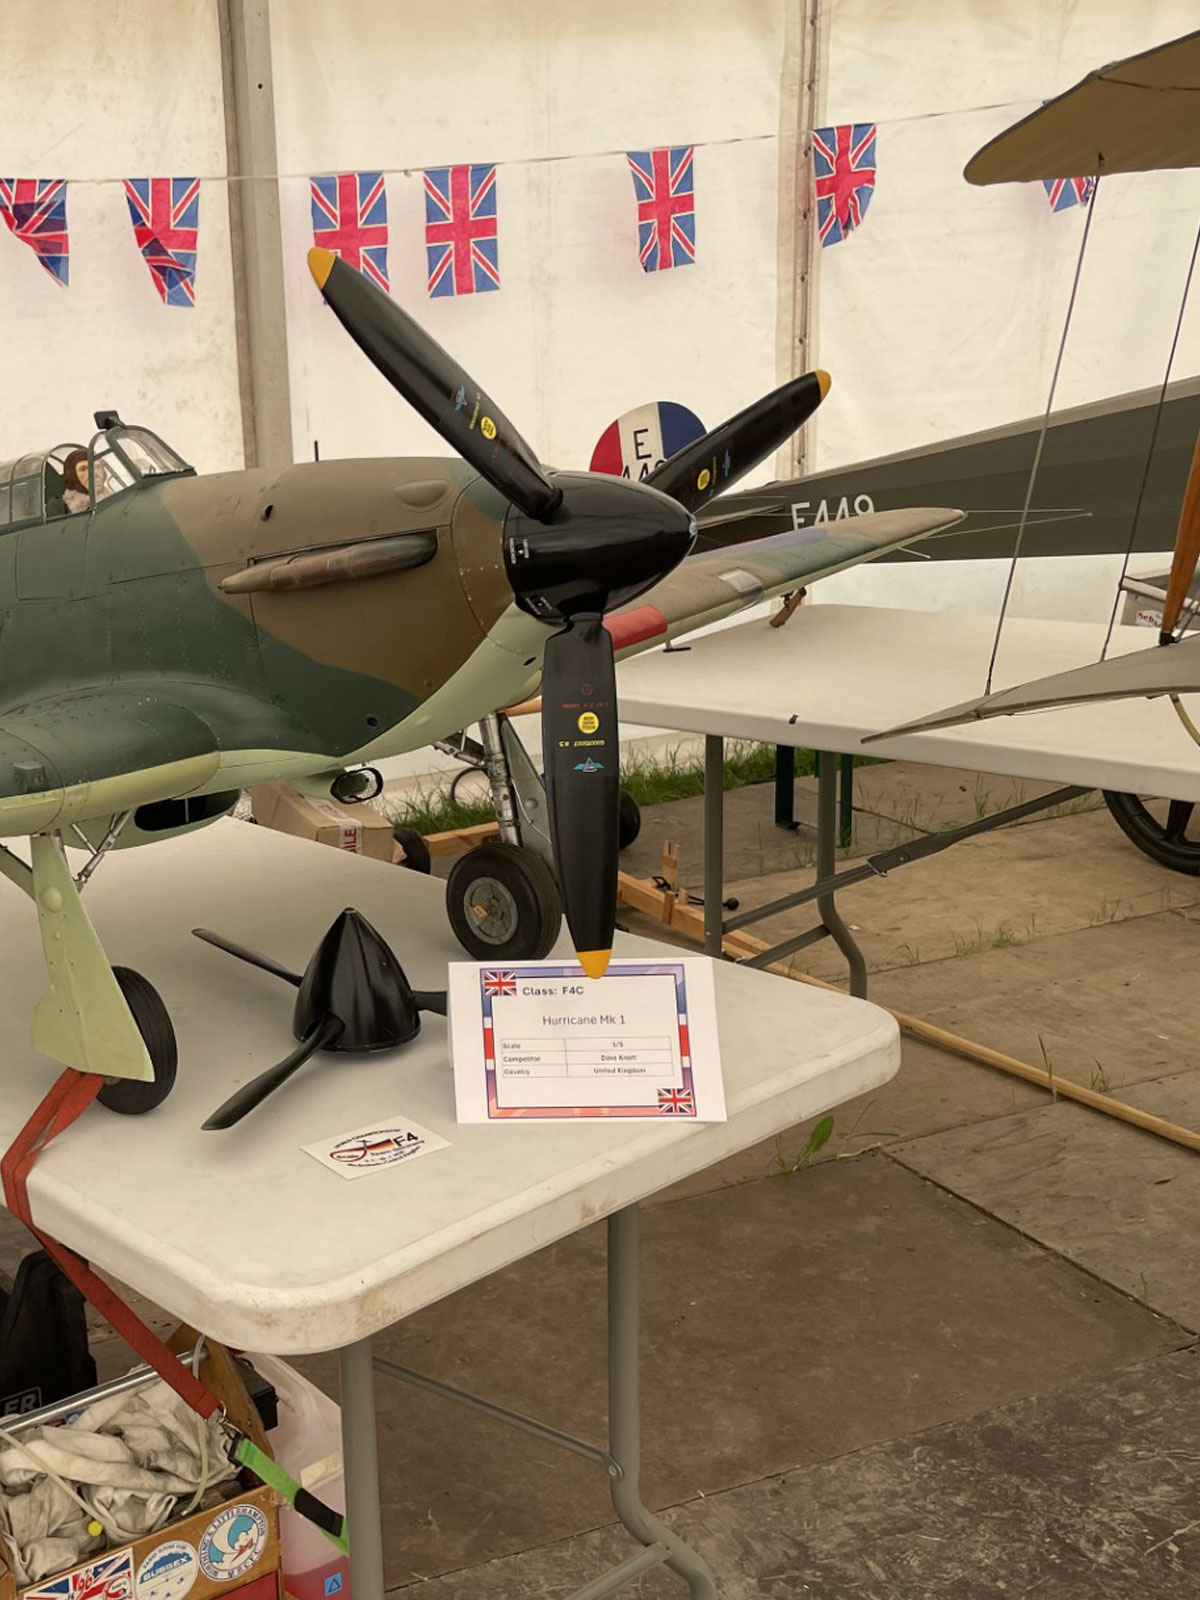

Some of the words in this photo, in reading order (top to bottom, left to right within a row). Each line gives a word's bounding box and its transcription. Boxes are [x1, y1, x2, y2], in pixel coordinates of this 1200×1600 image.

[633, 428, 652, 460] E
[522, 987, 558, 996] Class:
[562, 986, 585, 995] F4C
[542, 1015, 598, 1026] Hurricane
[600, 1014, 617, 1025] Mk
[620, 1014, 626, 1025] 1
[502, 1056, 542, 1064] Competitor
[593, 1067, 616, 1075] United
[617, 1067, 647, 1075] Kingdom
[393, 1131, 419, 1147] F4
